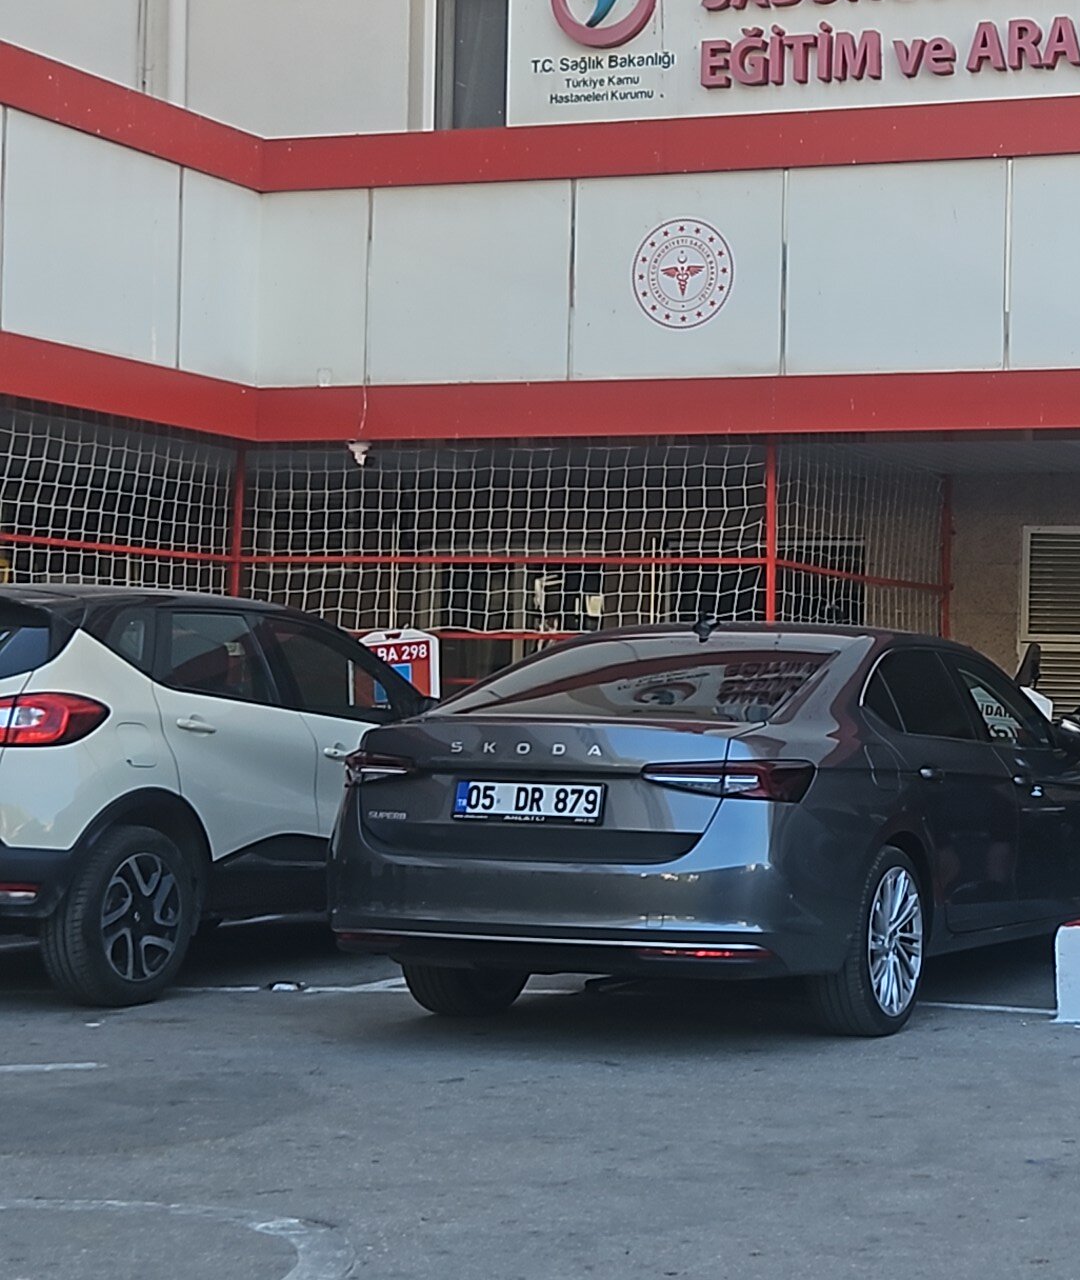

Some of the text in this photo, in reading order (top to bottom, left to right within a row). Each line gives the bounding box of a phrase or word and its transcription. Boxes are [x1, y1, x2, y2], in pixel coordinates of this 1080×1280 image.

[531, 51, 676, 74] T.C. Sağlık Bakanlığı
[701, 21, 881, 90] EĞİTİM
[893, 36, 956, 79] ve
[608, 75, 640, 86] Kamu
[550, 90, 654, 104] Hastaneleri Kurumu
[401, 644, 428, 660] 298
[450, 741, 602, 757] SKODA
[468, 785, 496, 810] 05
[514, 786, 544, 812] DR
[554, 788, 598, 814] 879
